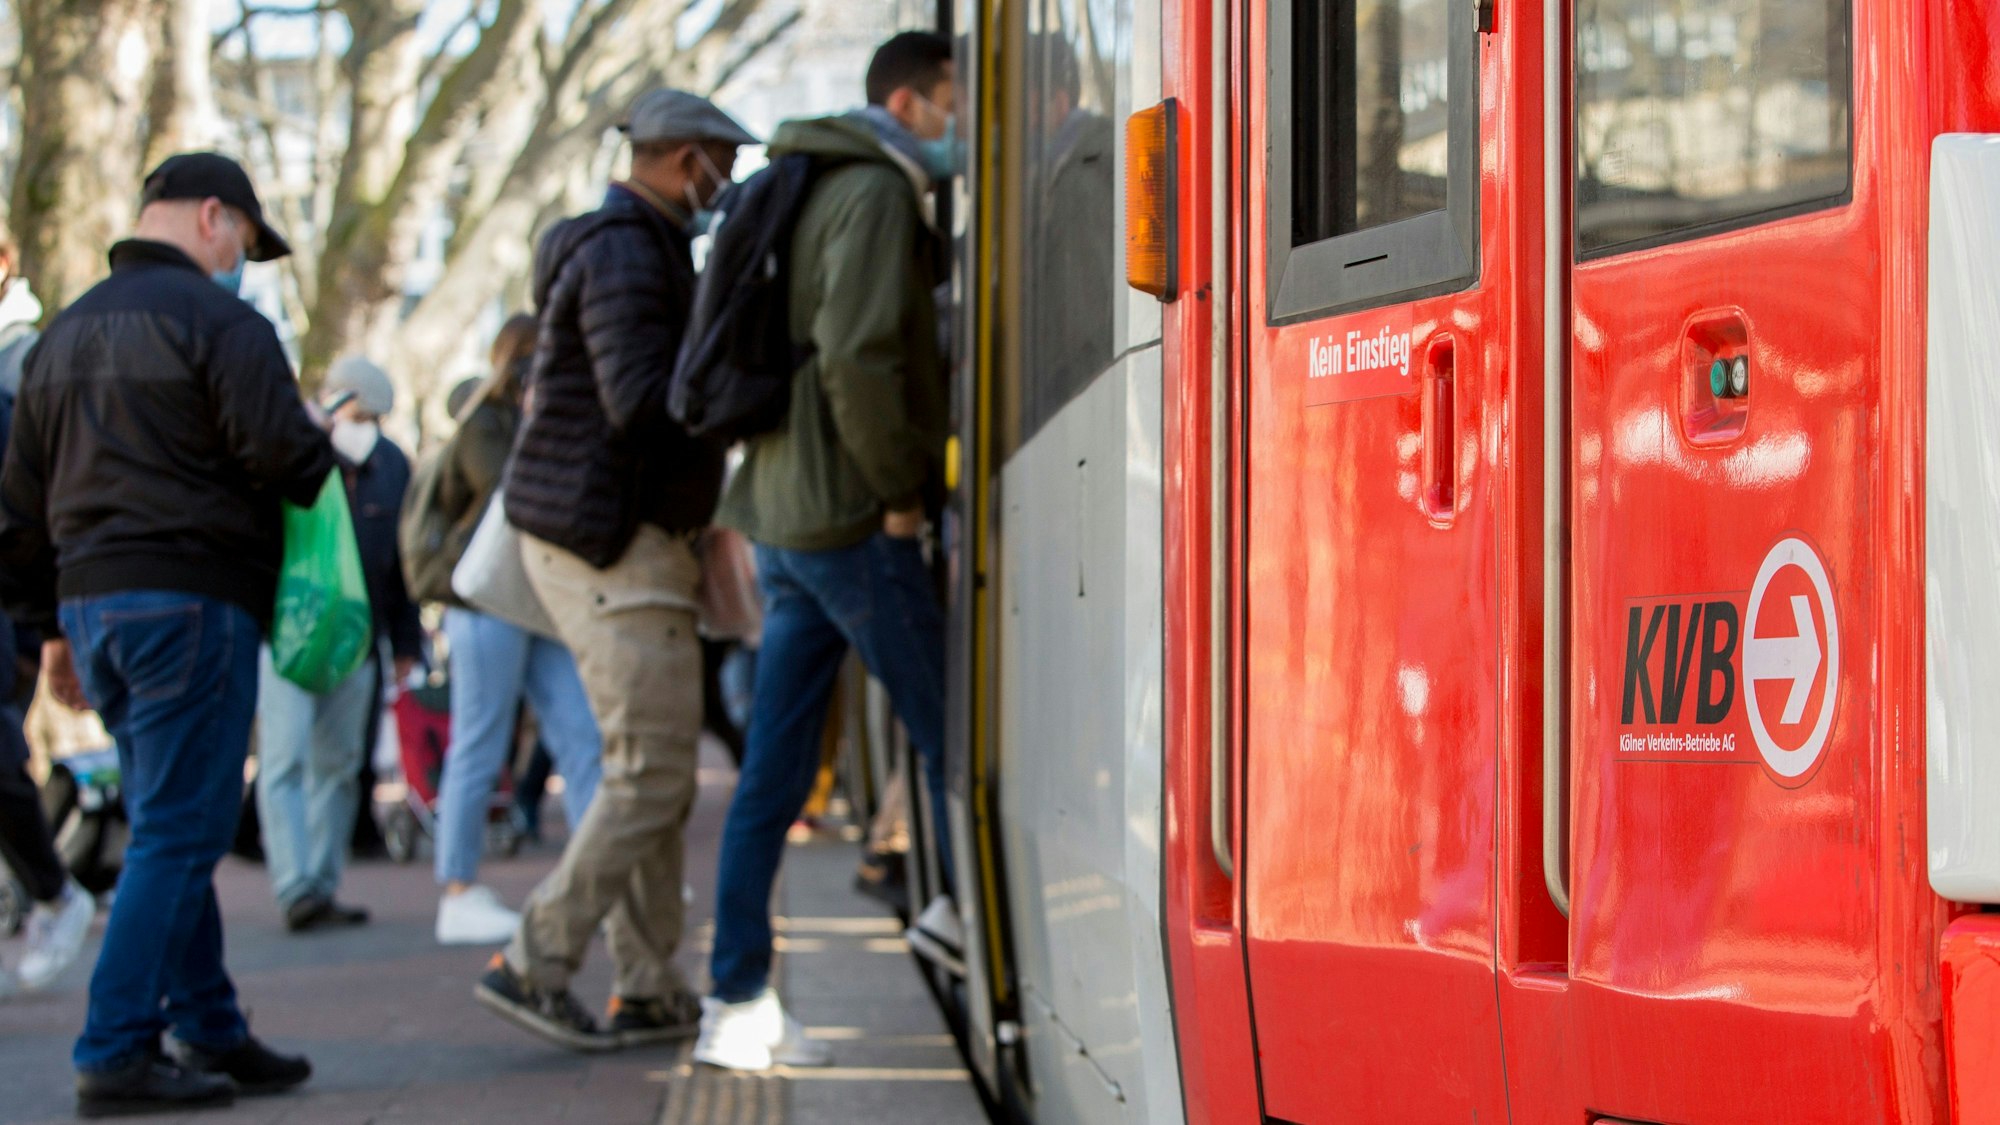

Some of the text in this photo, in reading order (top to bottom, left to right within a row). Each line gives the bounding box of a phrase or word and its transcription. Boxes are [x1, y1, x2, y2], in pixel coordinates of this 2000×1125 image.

[1309, 325, 1410, 378] Kein Einstieg
[1620, 601, 1739, 724] KVB
[1620, 732, 1735, 752] Kölner Verkehrs-Betriebe AG
